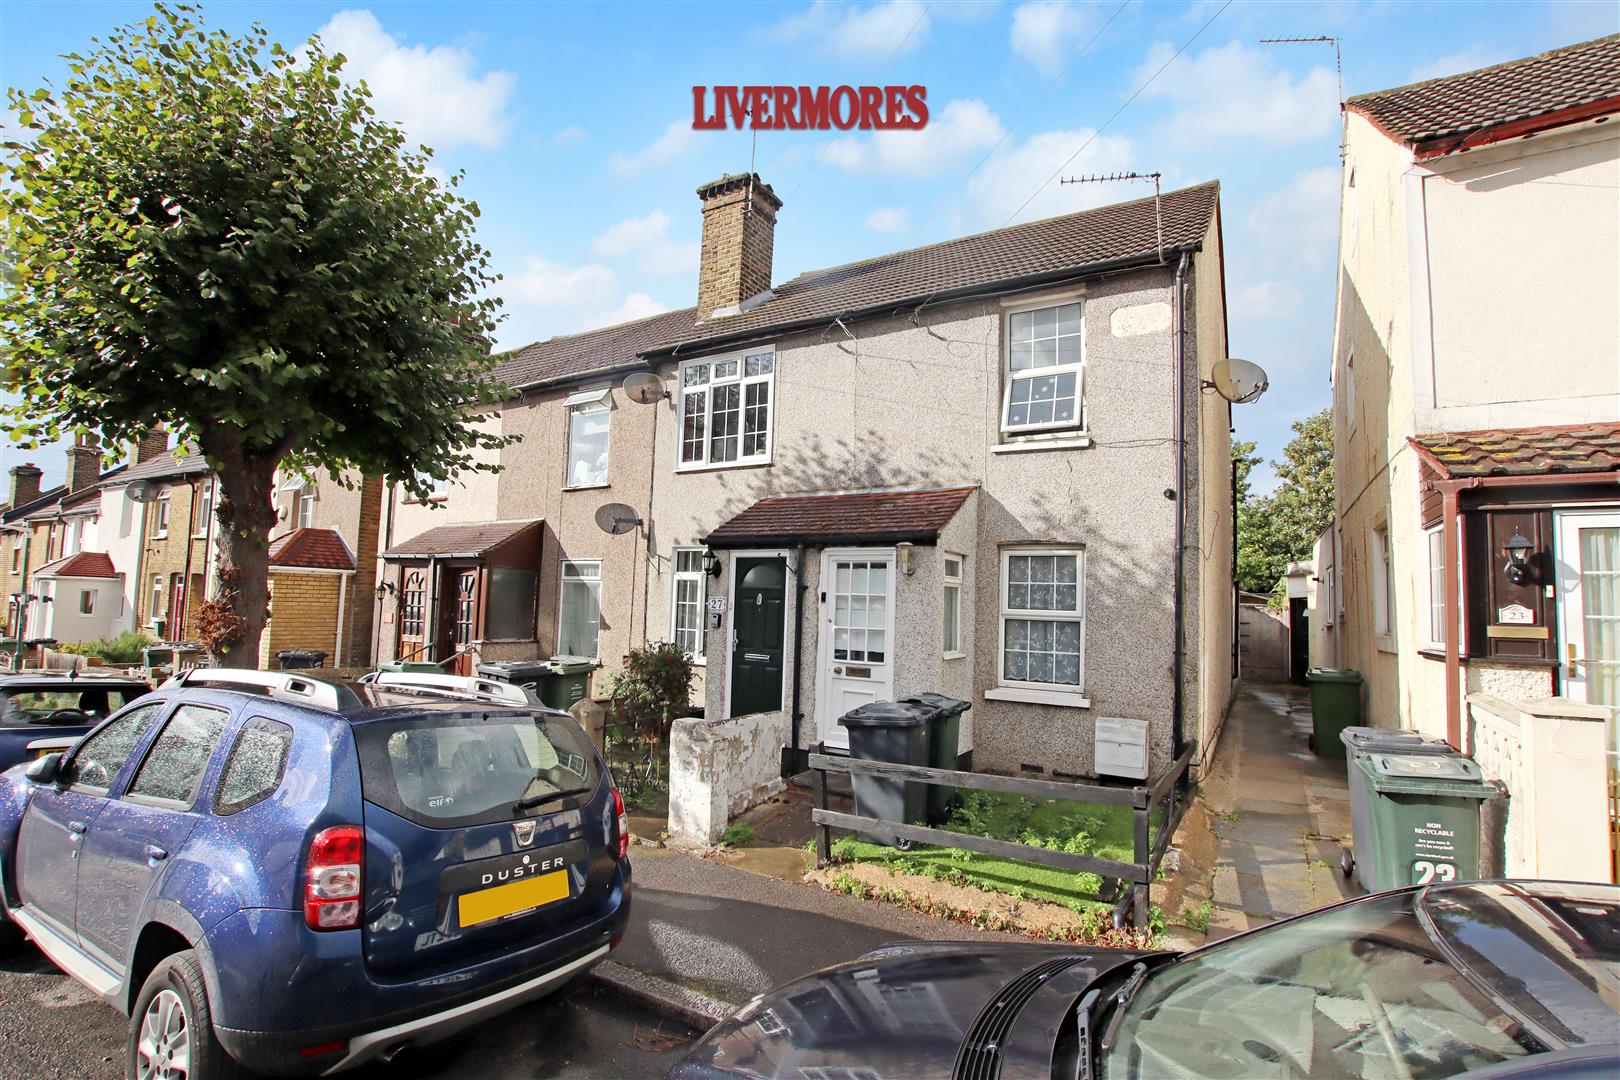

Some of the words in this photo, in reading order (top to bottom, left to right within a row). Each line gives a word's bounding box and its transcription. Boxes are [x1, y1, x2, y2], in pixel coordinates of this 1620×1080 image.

[711, 599, 723, 609] 27
[1509, 612, 1525, 620] 23
[429, 798, 444, 807] elf
[1414, 827, 1454, 837] RECYCLABLE
[482, 857, 564, 884] DUSTER
[1414, 861, 1456, 885] 23
